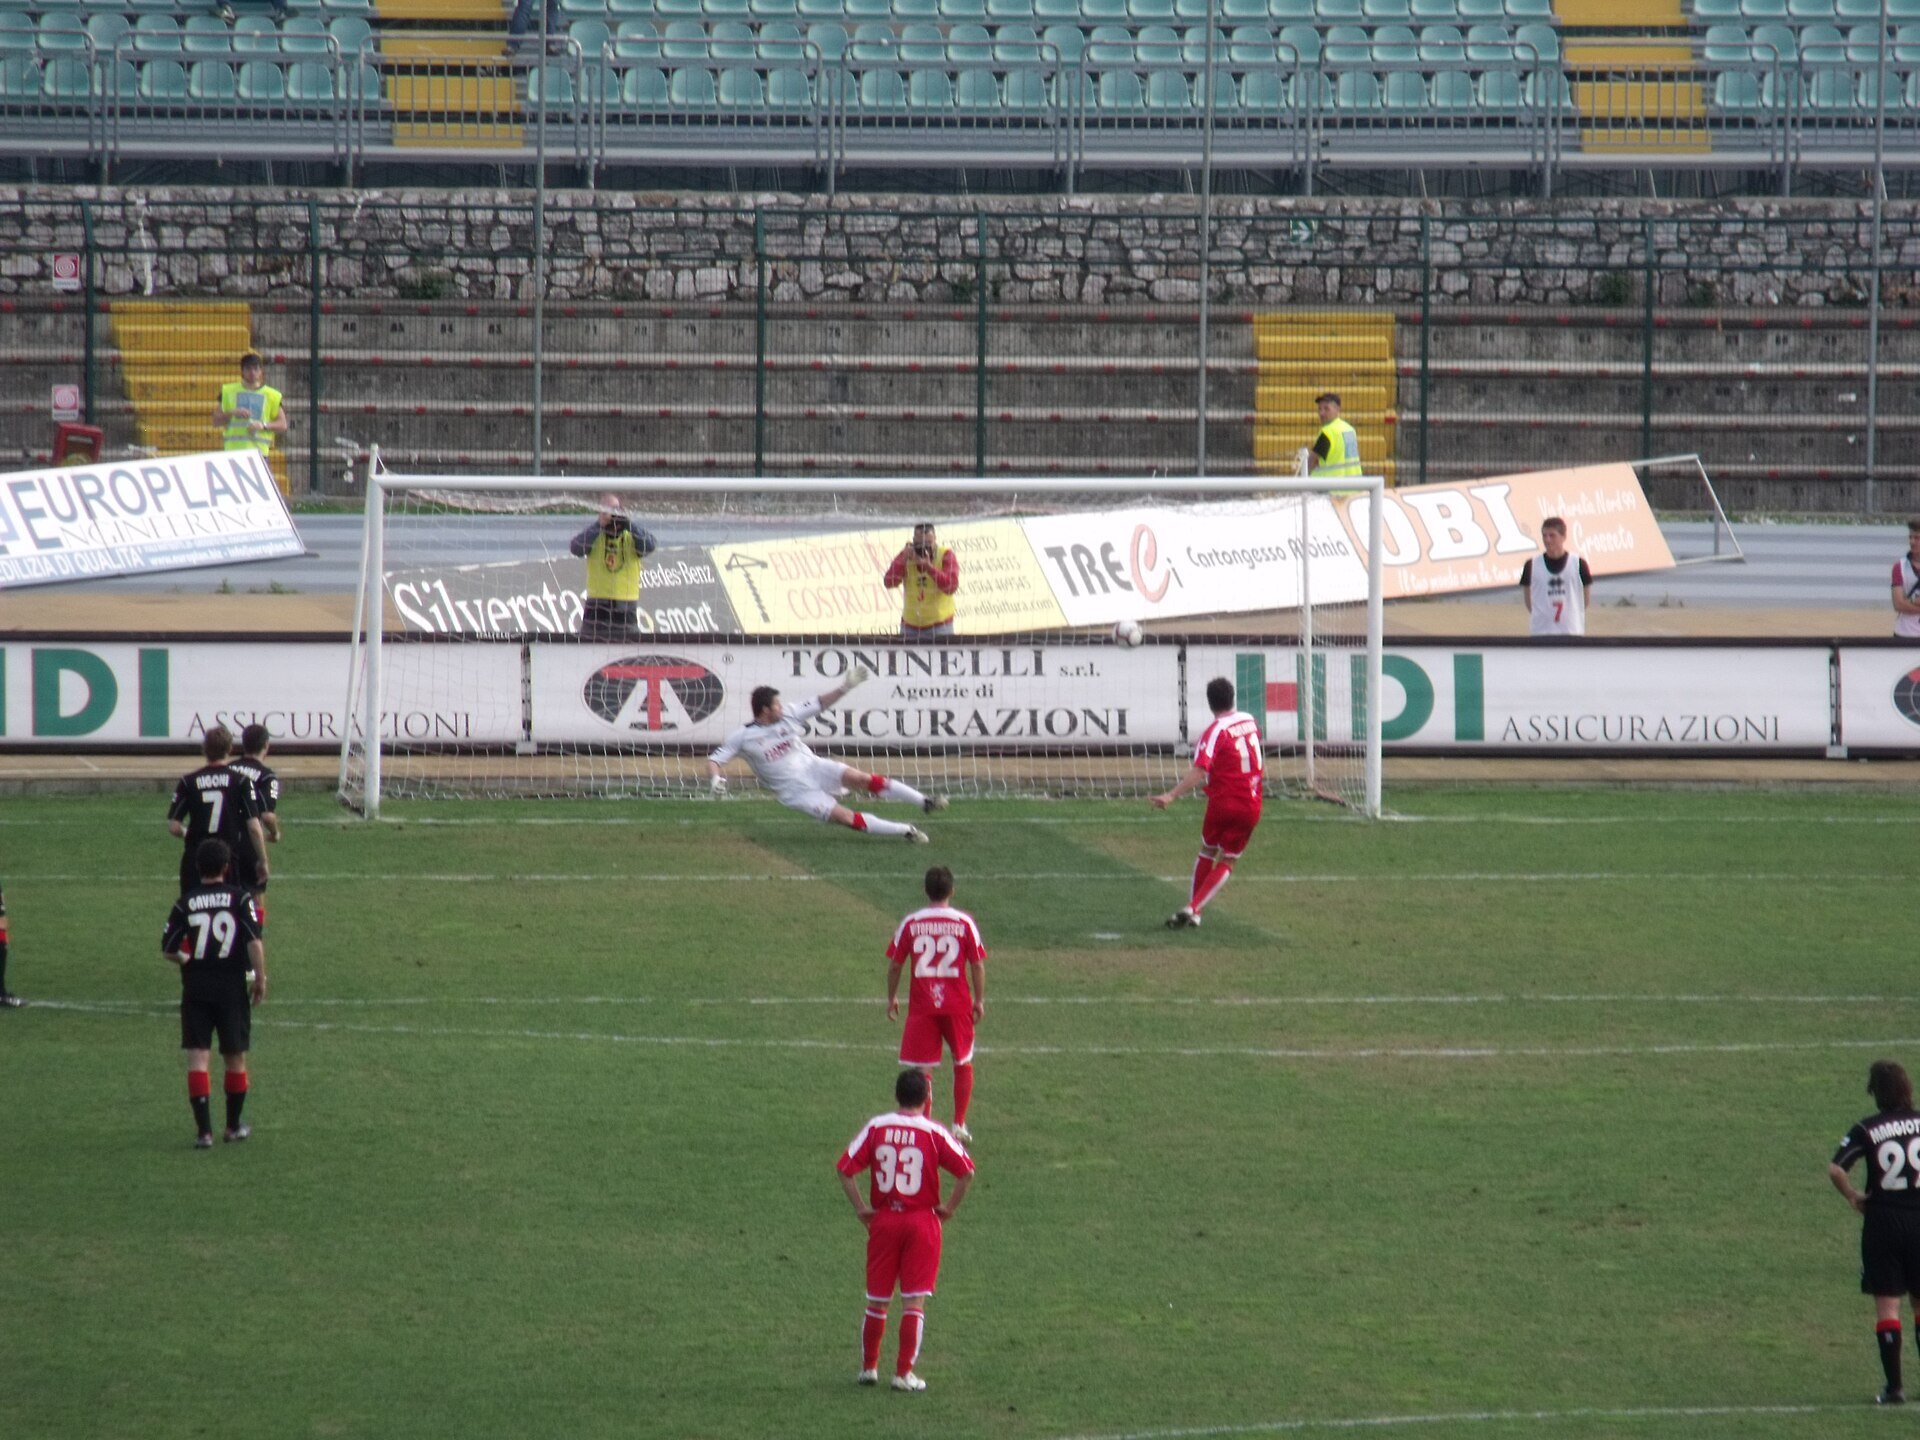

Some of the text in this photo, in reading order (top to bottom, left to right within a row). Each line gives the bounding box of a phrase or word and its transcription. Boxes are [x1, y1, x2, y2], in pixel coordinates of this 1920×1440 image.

[7, 456, 270, 550] EUROPLAN
[1347, 483, 1539, 566] OBI
[53, 553, 76, 577] DI
[639, 560, 715, 589] rcedes-Benz
[1186, 545, 1287, 571] Cartongesso
[394, 578, 590, 633] Silversta
[787, 582, 903, 621] COSTRUZI
[1552, 600, 1564, 624] 7
[782, 649, 1046, 678] TONINELLI
[0, 648, 169, 737] DI
[891, 682, 995, 703] Agenzie di
[1235, 653, 1781, 743] HDI ASSICURAZIONI
[800, 708, 1130, 738] SICURAZIONI
[1235, 733, 1263, 774] 11
[196, 773, 231, 789] RIGONI
[202, 790, 224, 834] 7
[188, 893, 232, 912] GAVAZZI
[188, 910, 237, 960] 79
[913, 934, 960, 979] 22
[874, 1144, 925, 1197] 33
